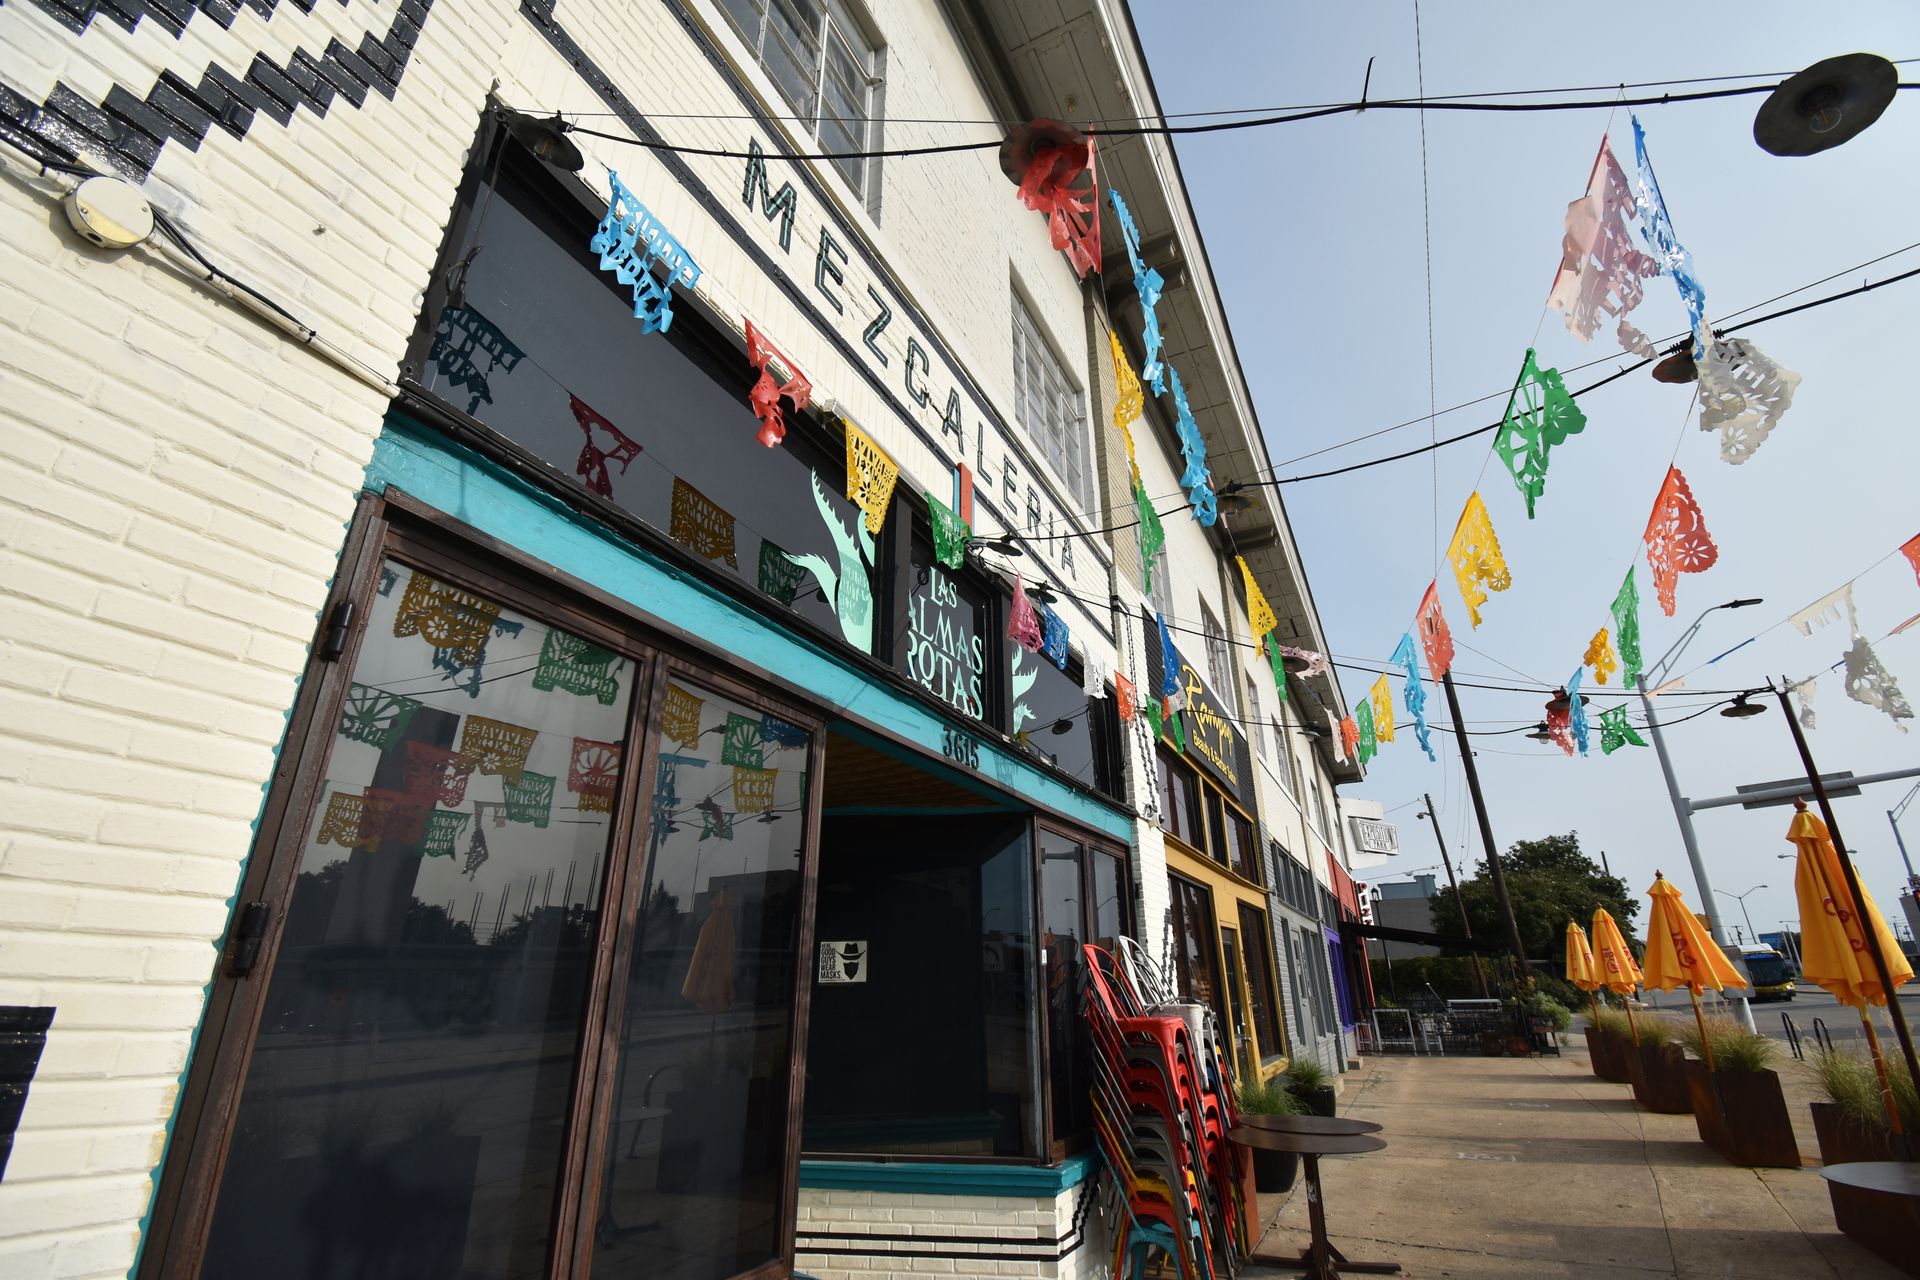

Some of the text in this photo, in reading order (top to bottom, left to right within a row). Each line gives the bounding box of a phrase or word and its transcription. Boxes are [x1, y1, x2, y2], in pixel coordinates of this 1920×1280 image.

[742, 135, 1077, 581] MEZCALERIA
[930, 566, 957, 609] LAS
[943, 724, 980, 771] 3615
[821, 956, 836, 964] GUYS
